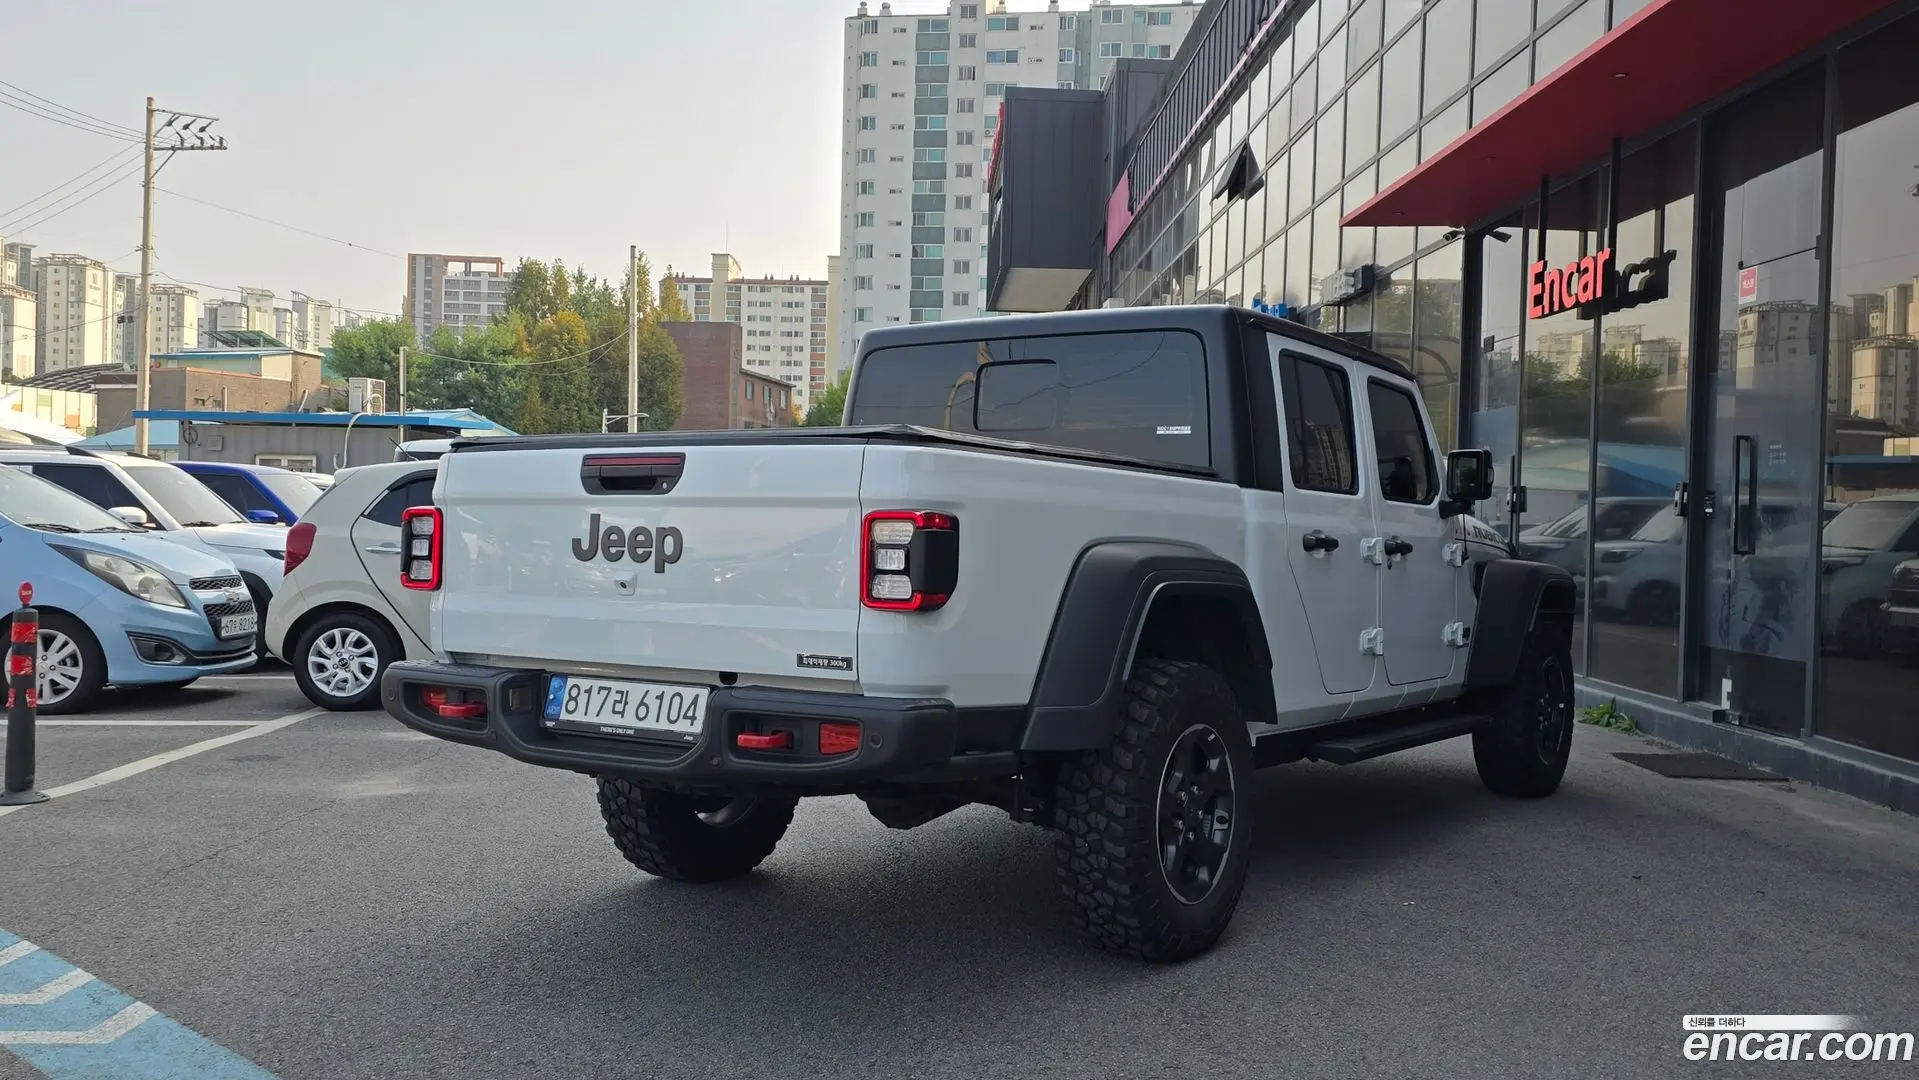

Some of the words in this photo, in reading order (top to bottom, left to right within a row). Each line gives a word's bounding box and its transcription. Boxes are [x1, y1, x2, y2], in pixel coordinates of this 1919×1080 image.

[1529, 248, 1611, 319] Encar
[572, 513, 683, 573] Jeep
[564, 683, 629, 718] 817라
[635, 689, 700, 727] 6104
